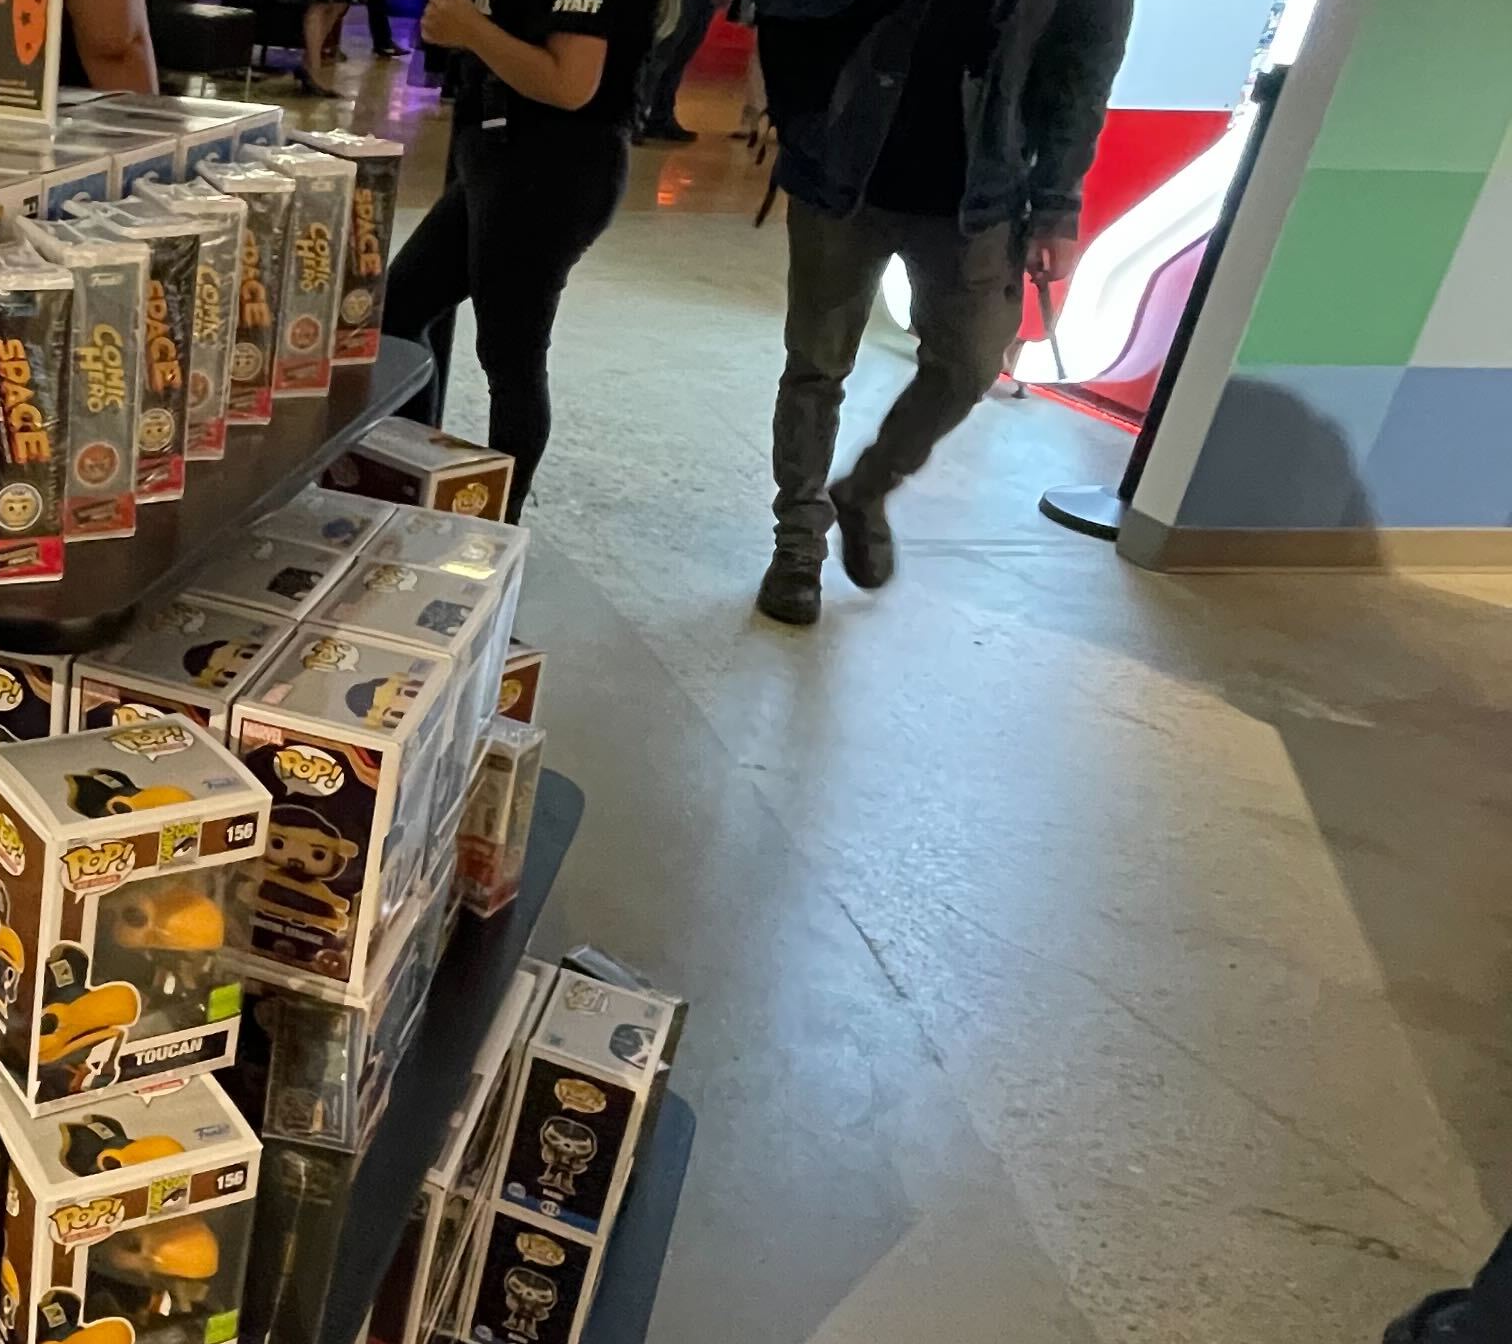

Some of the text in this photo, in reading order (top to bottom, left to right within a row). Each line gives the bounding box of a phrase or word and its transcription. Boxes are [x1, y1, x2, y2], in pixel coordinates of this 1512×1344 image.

[76, 343, 102, 415] HERO
[92, 323, 127, 414] COMIC
[274, 749, 343, 790] POP!
[225, 822, 255, 844] 156
[59, 840, 136, 882] POP!
[134, 1036, 204, 1067] TOUCAN
[215, 1169, 245, 1192] 156
[48, 1197, 123, 1238] POP!
